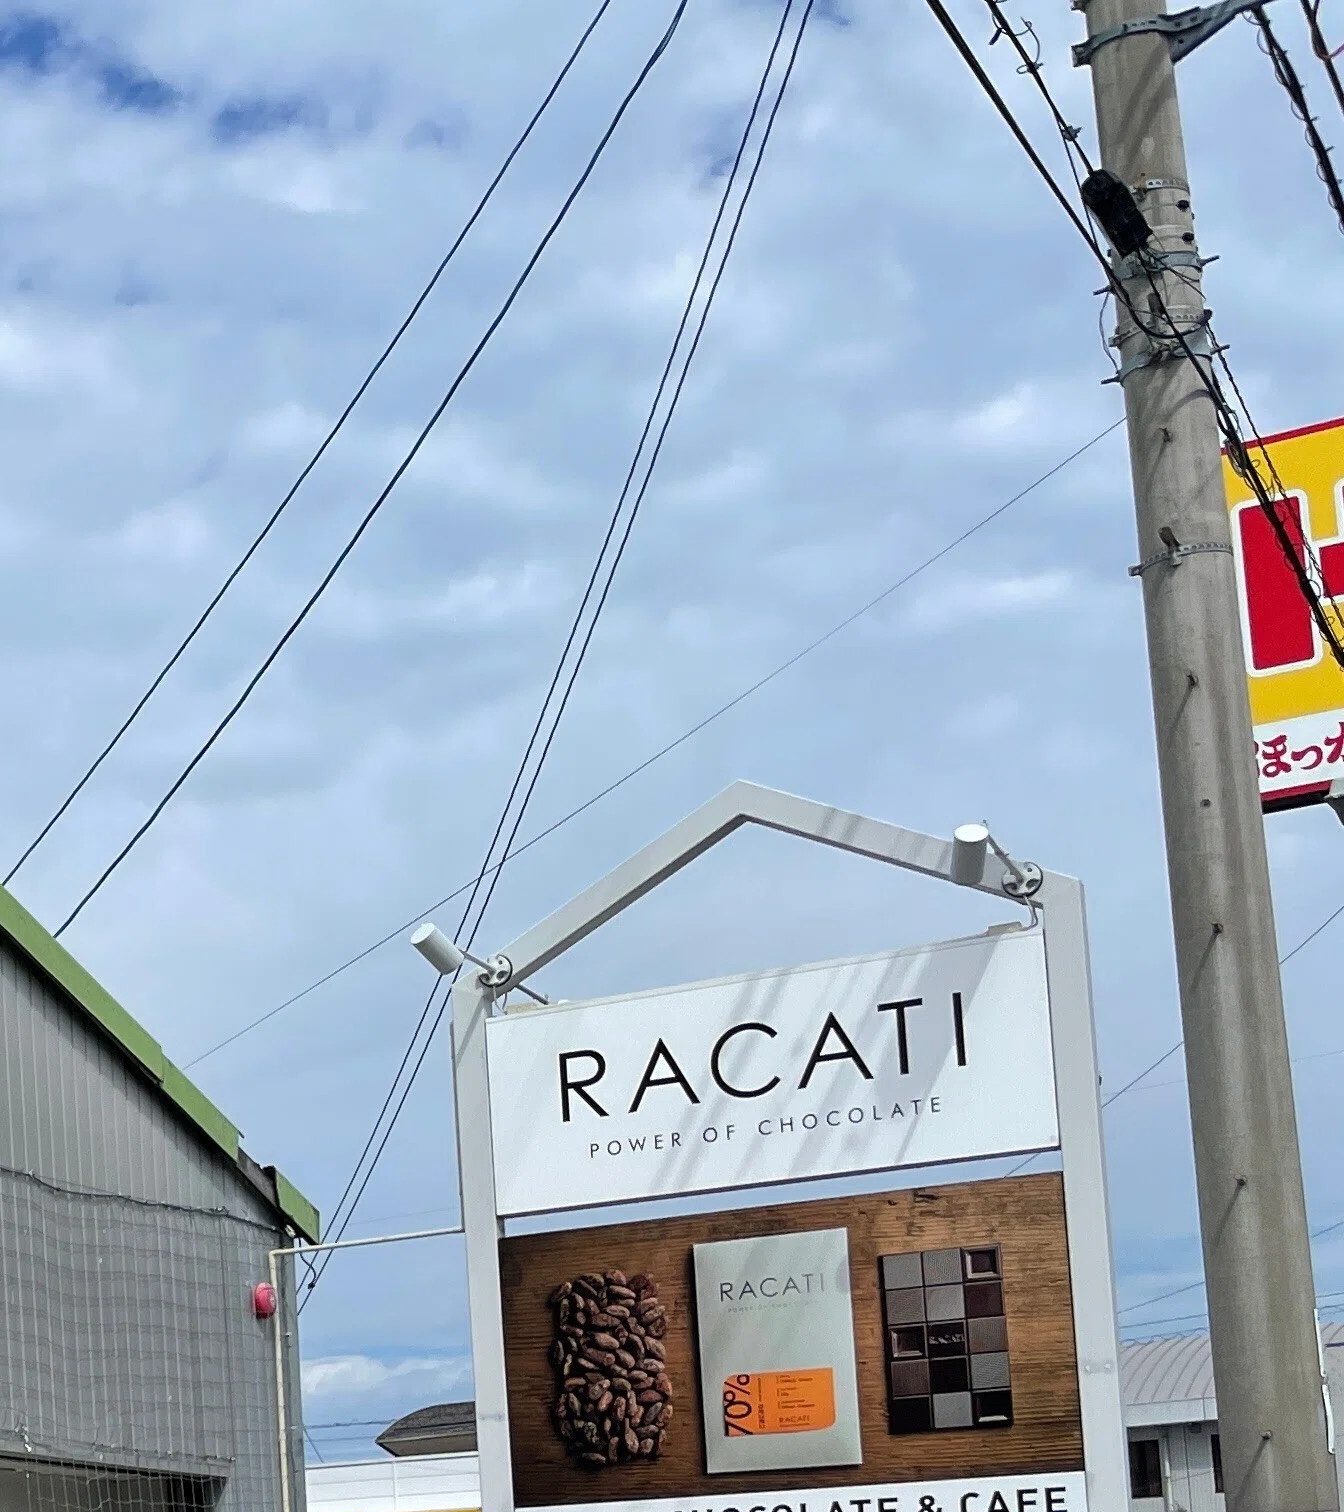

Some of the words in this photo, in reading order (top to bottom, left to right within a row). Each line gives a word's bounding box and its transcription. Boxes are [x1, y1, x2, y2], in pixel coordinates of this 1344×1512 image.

[558, 991, 967, 1123] RACATI
[589, 1132, 683, 1159] POWER
[702, 1124, 737, 1144] OF
[757, 1096, 943, 1137] CHOCOLATE
[719, 1273, 825, 1303] RACATI
